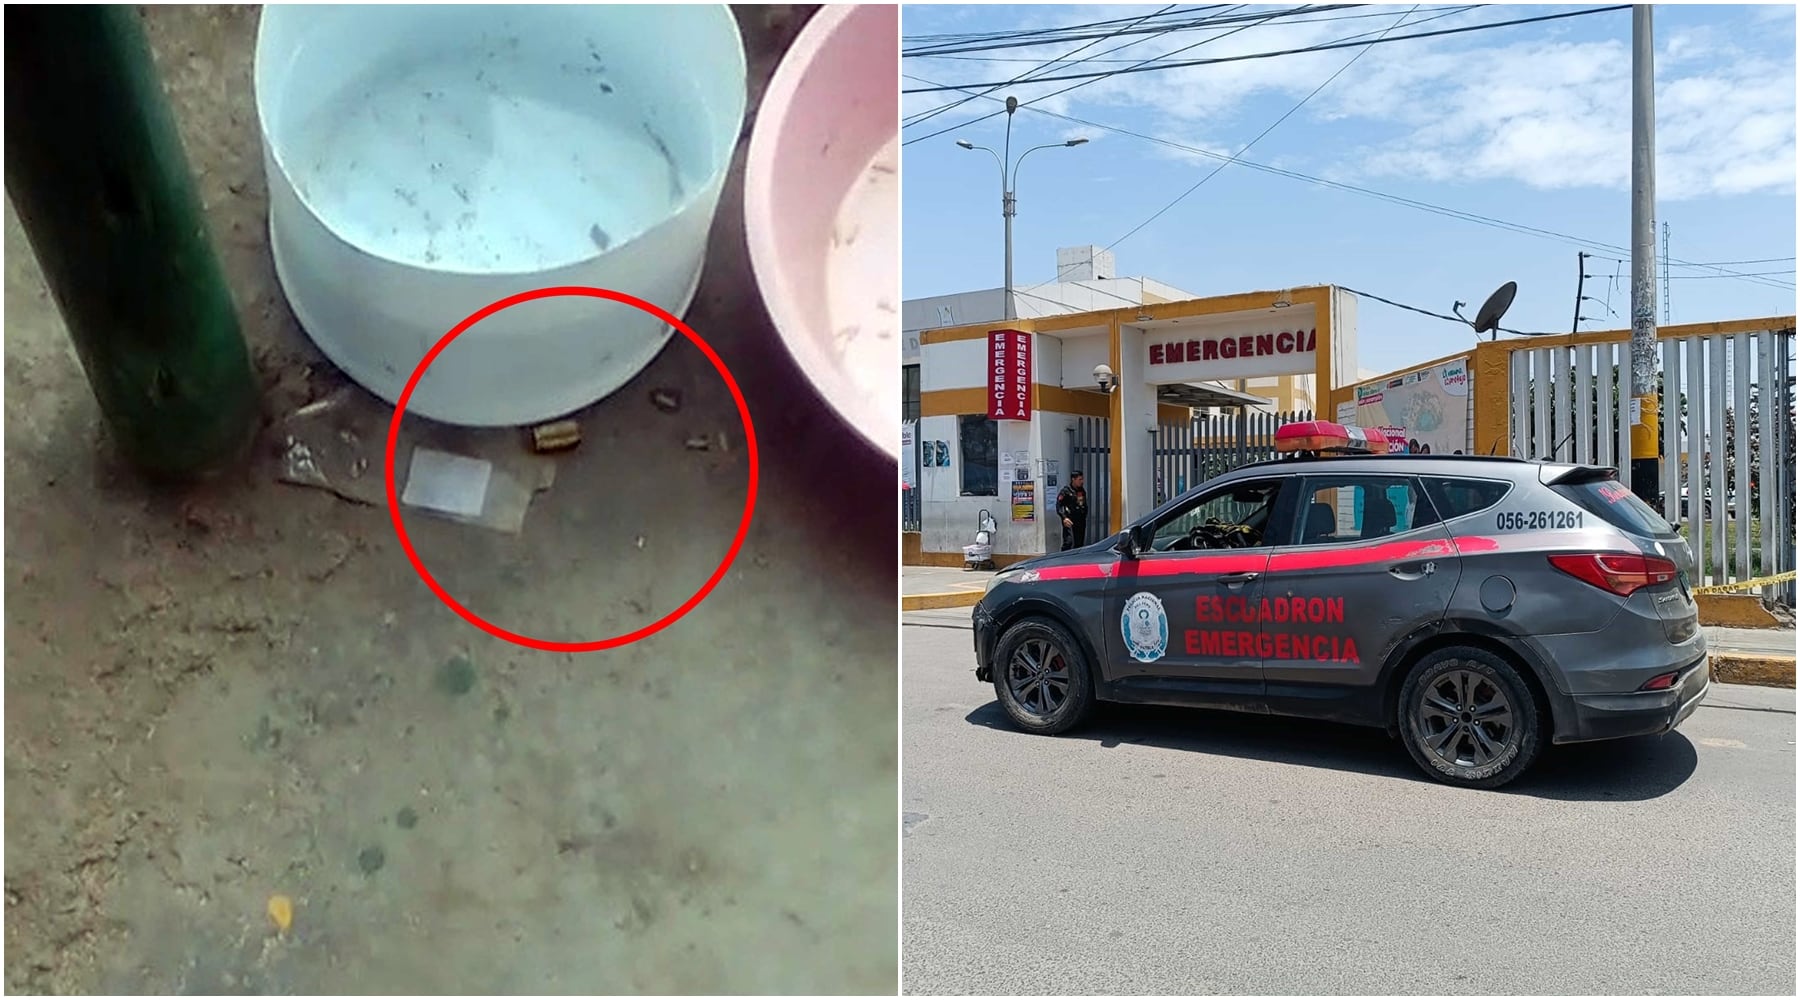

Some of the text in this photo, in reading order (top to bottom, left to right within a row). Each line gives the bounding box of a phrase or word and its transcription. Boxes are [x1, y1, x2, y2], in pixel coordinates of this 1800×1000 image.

[994, 333, 1006, 416] EMERGENCIA
[1016, 334, 1027, 417] EMERGENCIA
[1496, 511, 1584, 530] 056-261261
[1196, 595, 1344, 624] ESCUADRON
[1184, 629, 1360, 664] EMERGENCIA
